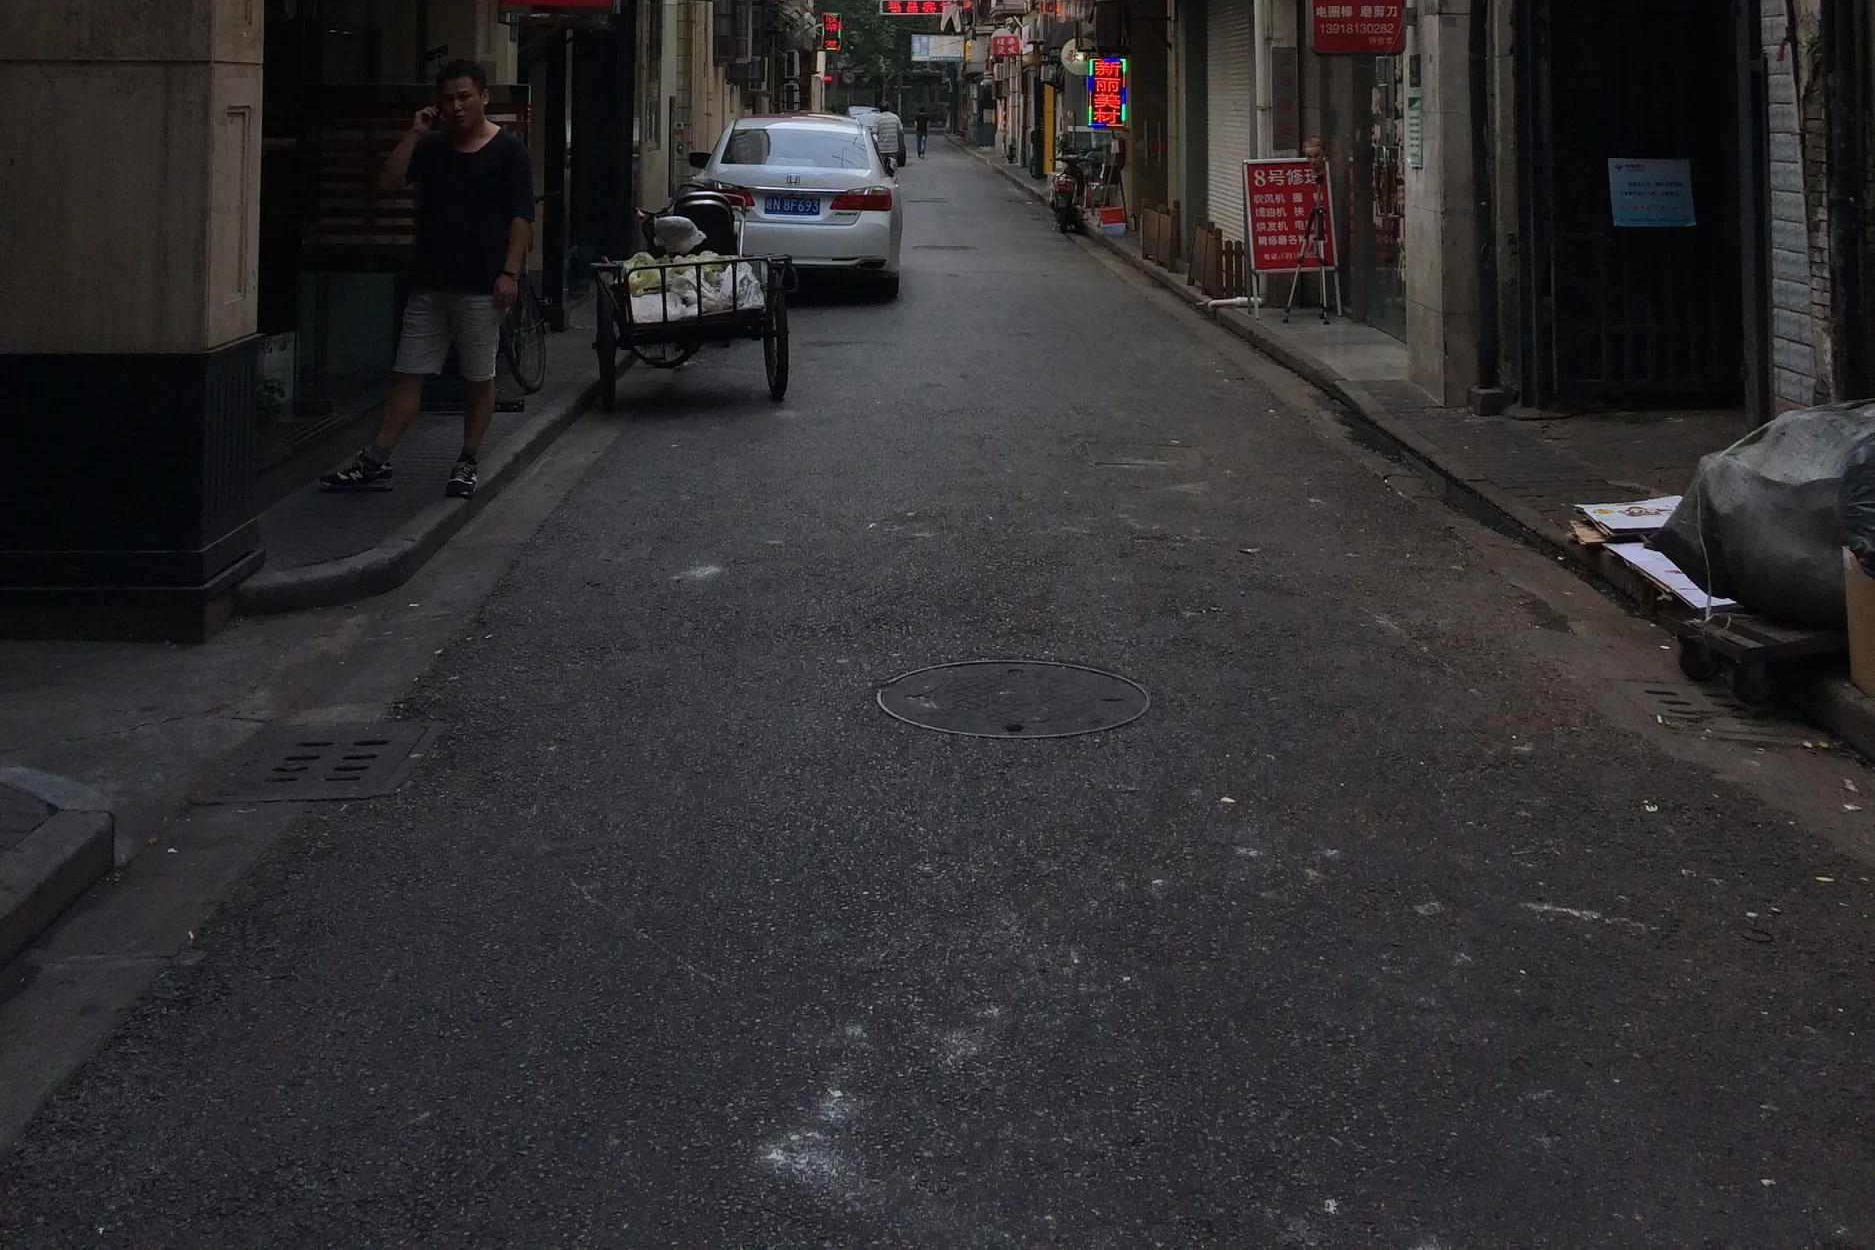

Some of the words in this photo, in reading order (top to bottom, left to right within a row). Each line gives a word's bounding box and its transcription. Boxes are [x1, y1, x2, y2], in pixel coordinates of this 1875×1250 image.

[1359, 4, 1398, 19] 磨剪刀
[1319, 23, 1395, 35] 13918130282
[1093, 60, 1122, 124] 新丽美材
[1253, 193, 1286, 205] 吹风机
